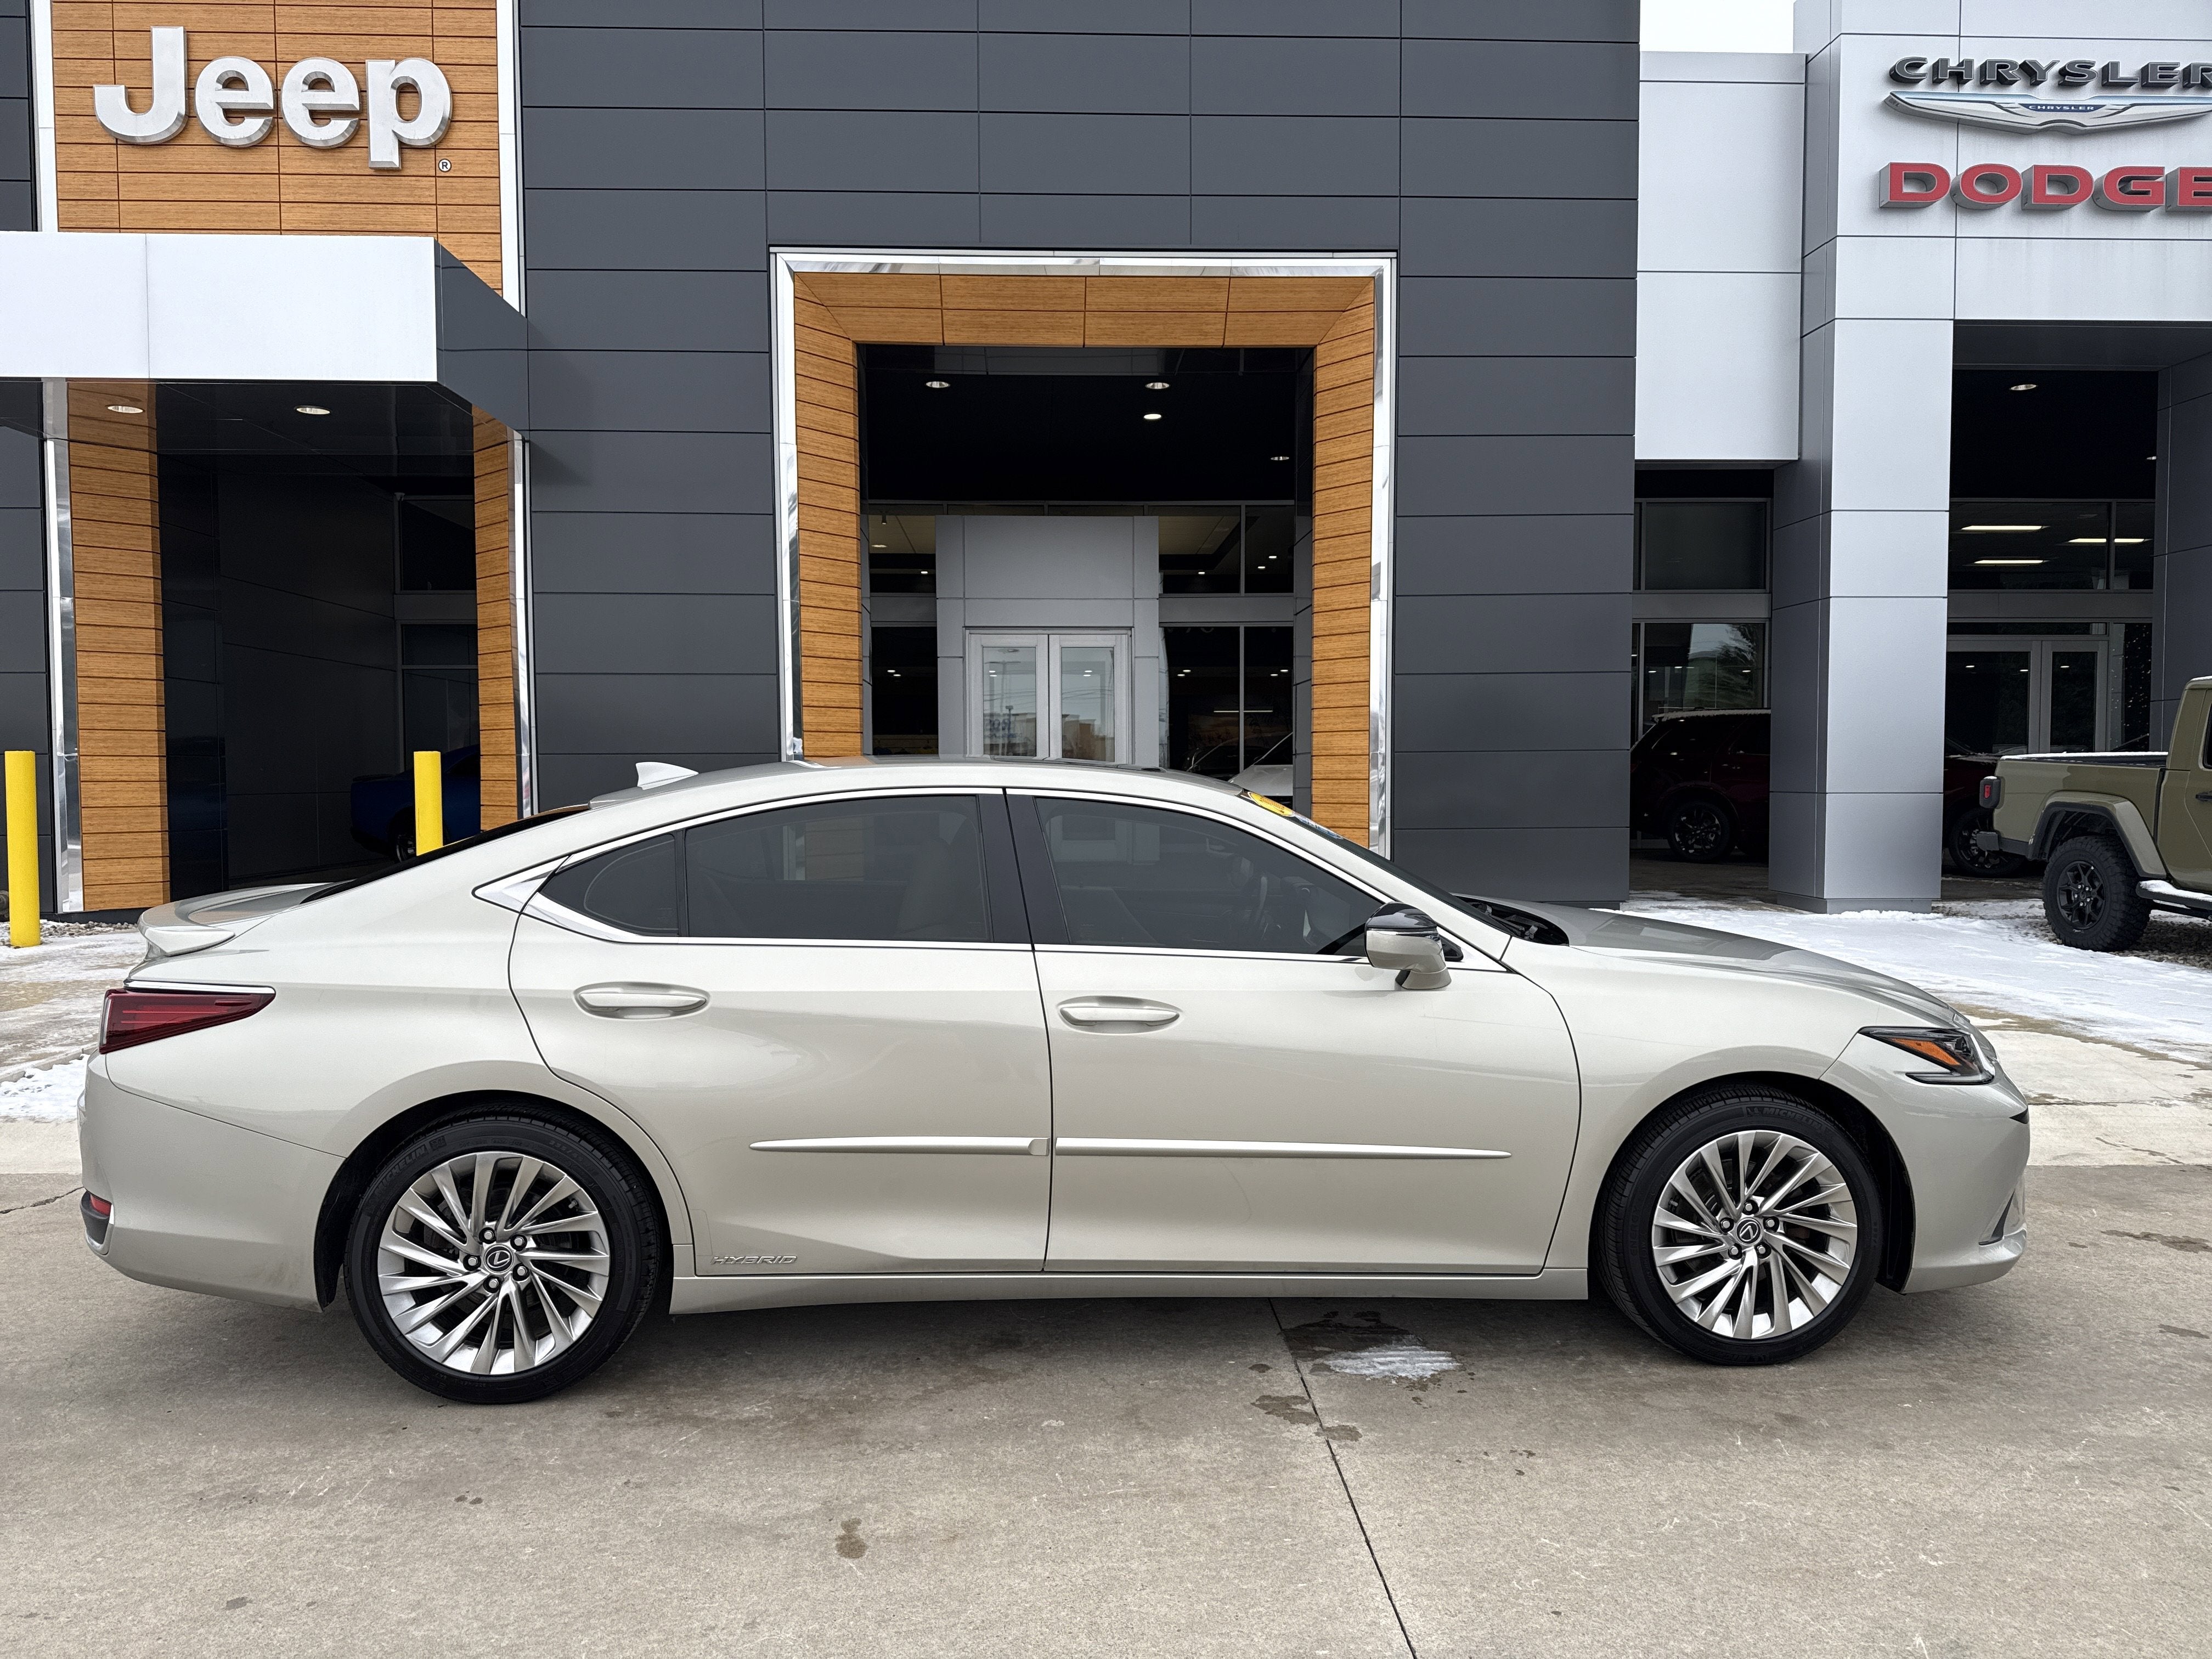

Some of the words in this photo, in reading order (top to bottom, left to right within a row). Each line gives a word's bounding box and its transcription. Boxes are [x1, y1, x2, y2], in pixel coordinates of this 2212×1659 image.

[1889, 57, 2212, 89] CHRYSLER
[93, 26, 453, 170] Jeep
[1880, 162, 2212, 212] DODGE
[1763, 1107, 1823, 1128] MICHELIN
[374, 1144, 428, 1195] MICHELIN
[711, 1255, 798, 1265] HYBRID
